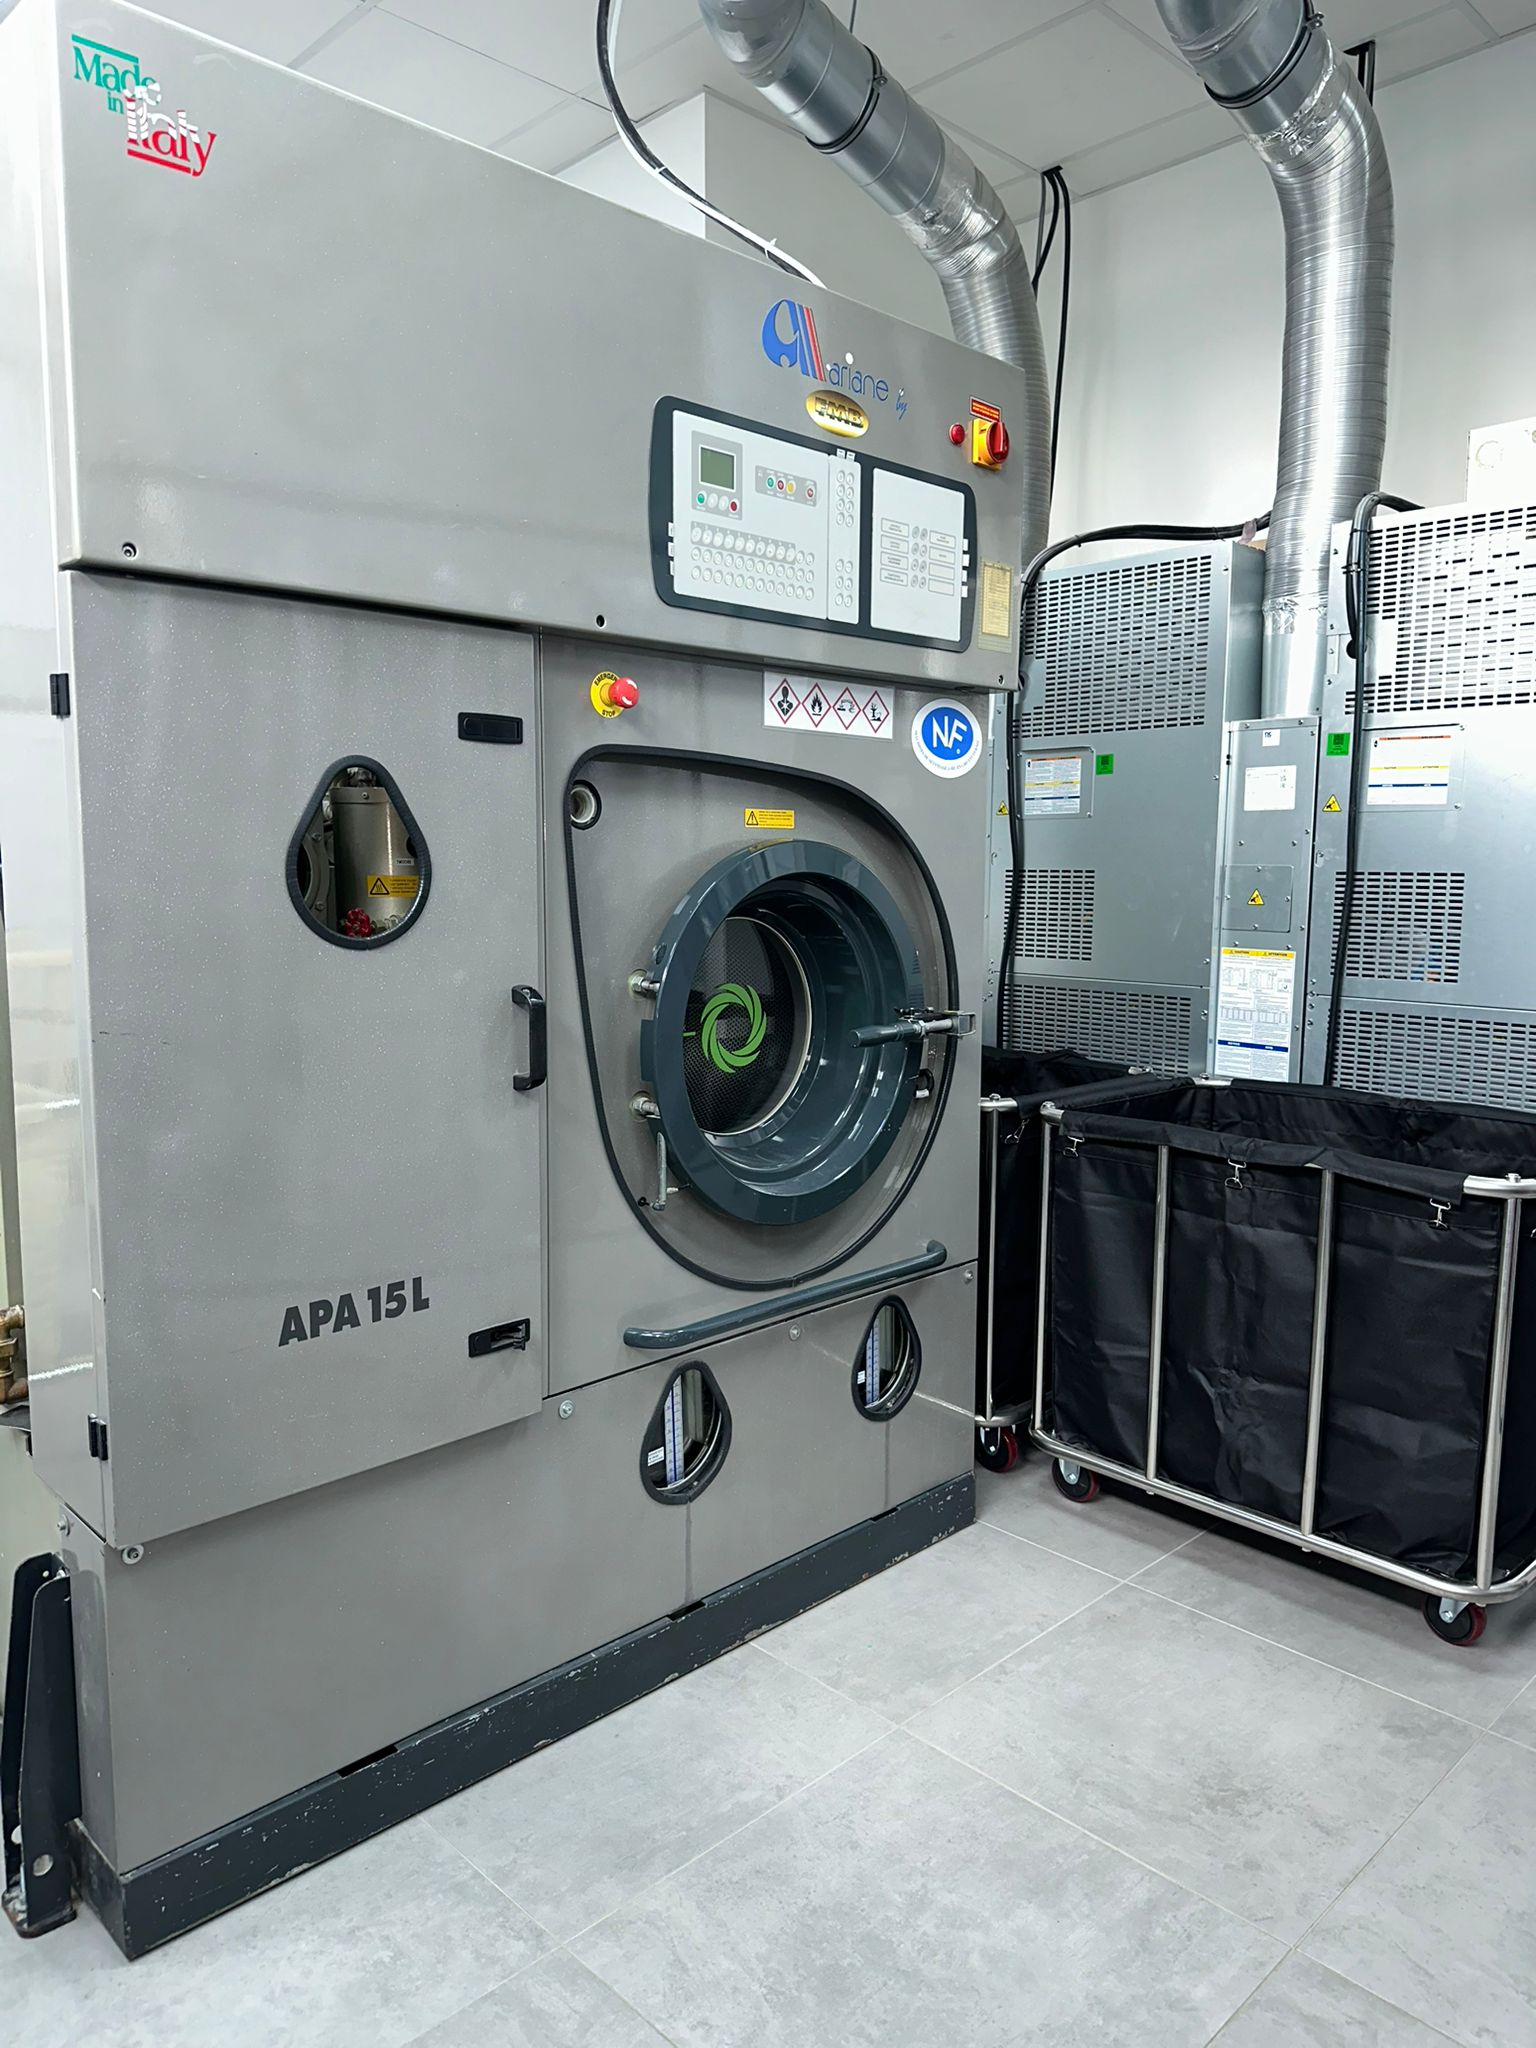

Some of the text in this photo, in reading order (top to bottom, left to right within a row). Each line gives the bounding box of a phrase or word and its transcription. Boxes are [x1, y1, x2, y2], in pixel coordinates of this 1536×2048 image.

[73, 46, 161, 105] Made
[107, 92, 124, 115] in
[126, 97, 217, 177] Italy
[814, 397, 865, 429] FMB
[601, 709, 616, 718] STOP
[932, 715, 968, 750] NF
[278, 1292, 361, 1347] APA
